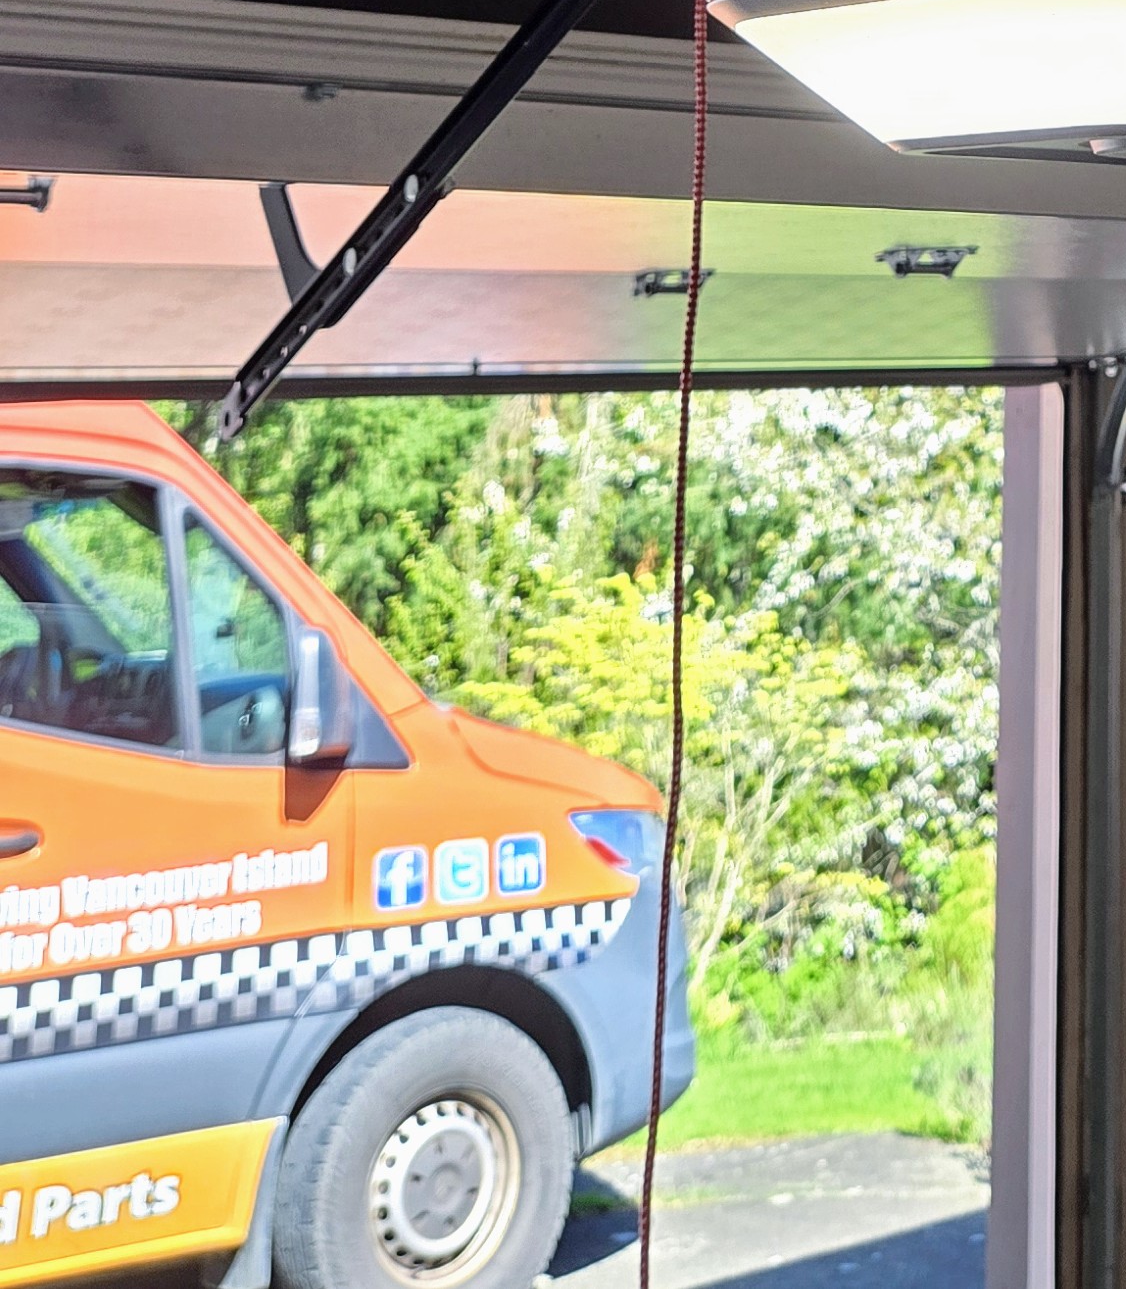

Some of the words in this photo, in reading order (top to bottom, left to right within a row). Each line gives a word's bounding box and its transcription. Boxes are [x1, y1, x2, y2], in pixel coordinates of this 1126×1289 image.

[61, 861, 232, 918] Vancouver
[232, 841, 328, 893] Island
[49, 920, 127, 964] Over
[126, 908, 173, 953] 30
[174, 900, 262, 946] Years
[30, 1171, 180, 1239] Parts
